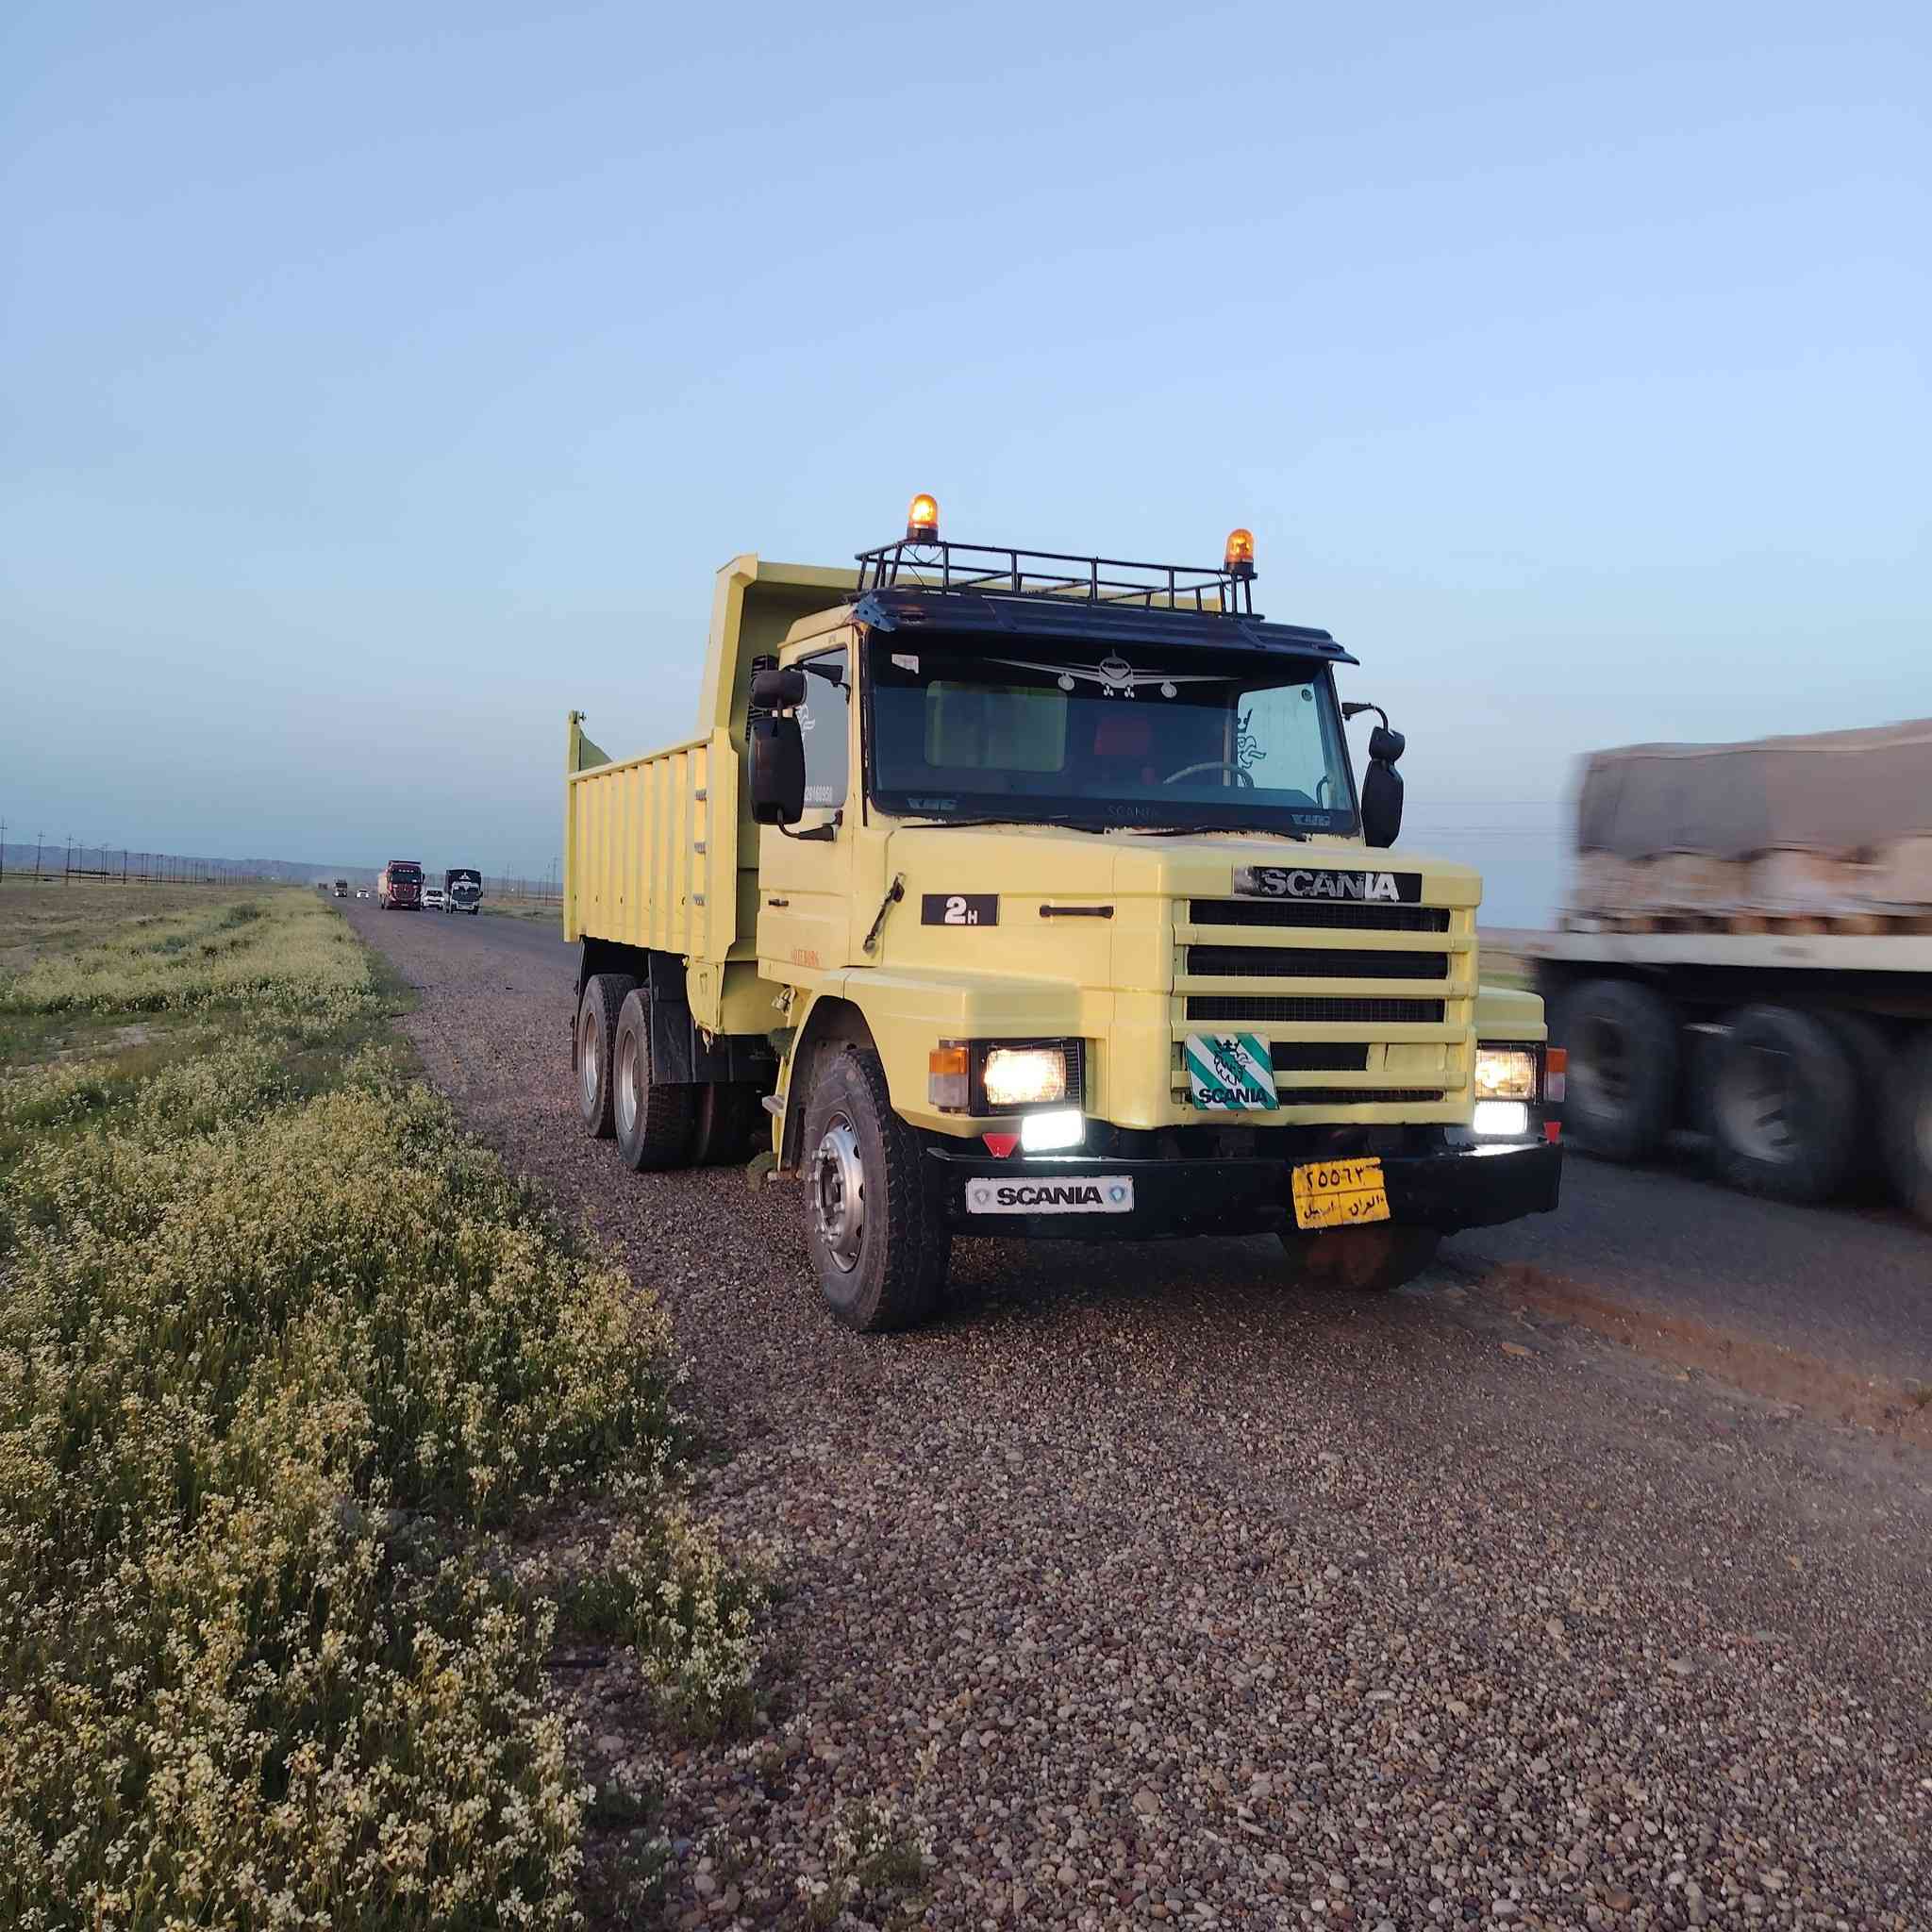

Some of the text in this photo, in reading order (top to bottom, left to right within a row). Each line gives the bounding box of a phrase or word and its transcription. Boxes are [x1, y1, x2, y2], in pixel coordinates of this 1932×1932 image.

[1260, 869, 1400, 901] SCANIA
[1199, 1088, 1268, 1104] SCANIA
[997, 1186, 1103, 1206] SCANIA
